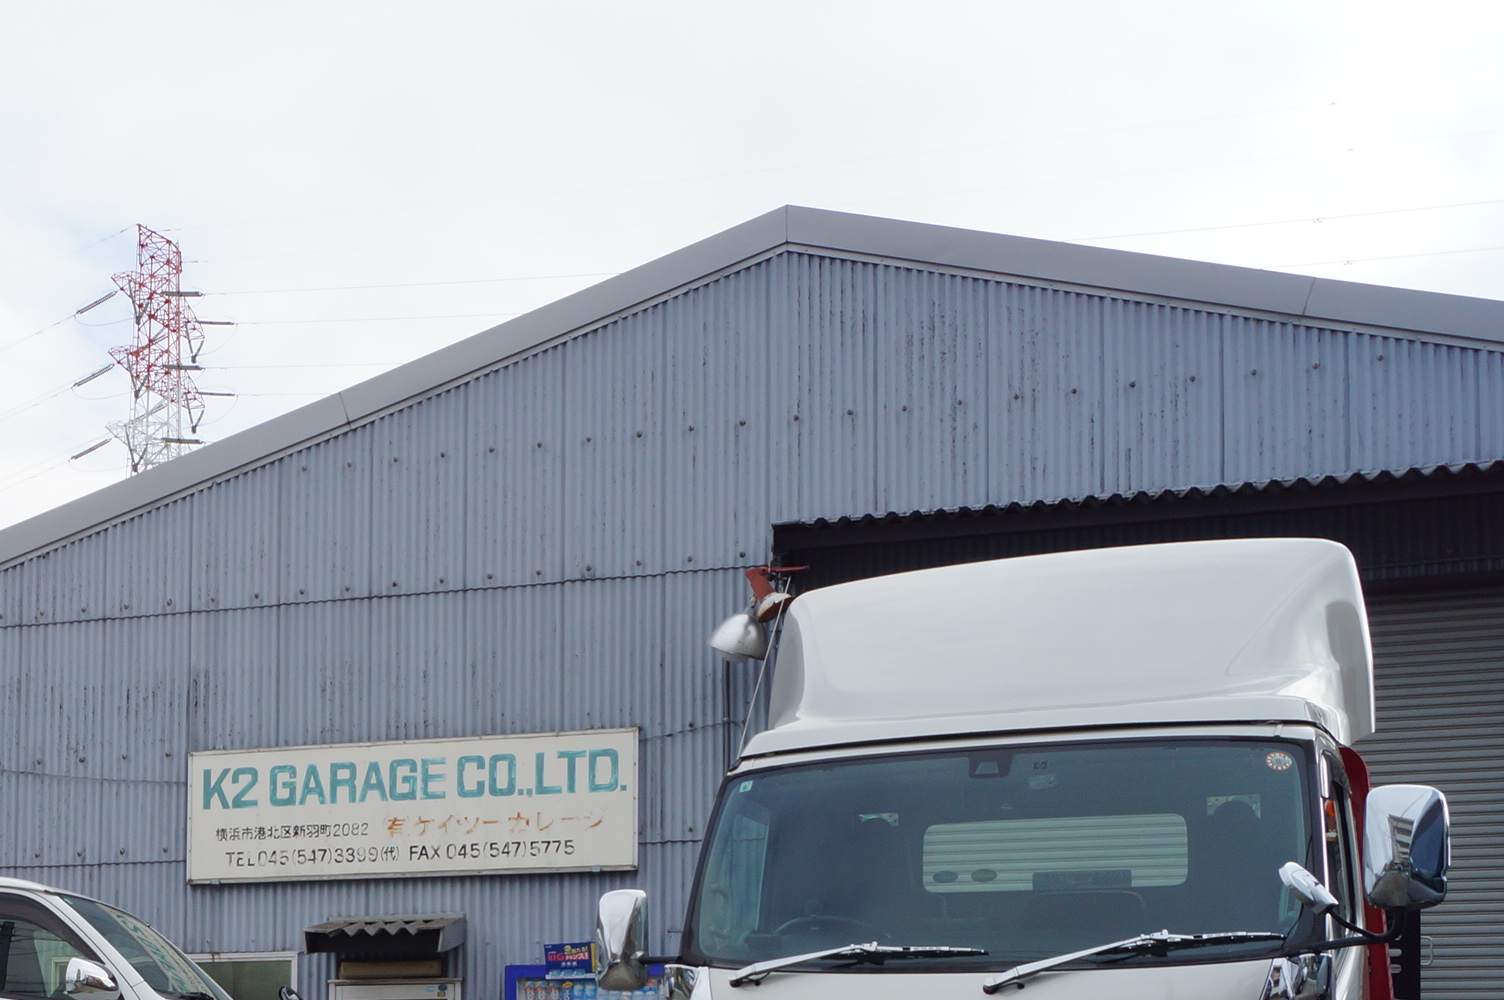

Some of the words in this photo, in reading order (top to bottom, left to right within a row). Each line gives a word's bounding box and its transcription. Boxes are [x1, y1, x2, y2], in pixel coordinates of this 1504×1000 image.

[202, 766, 259, 810] K2
[269, 757, 446, 807] GARAGE
[409, 844, 441, 861] FAX
